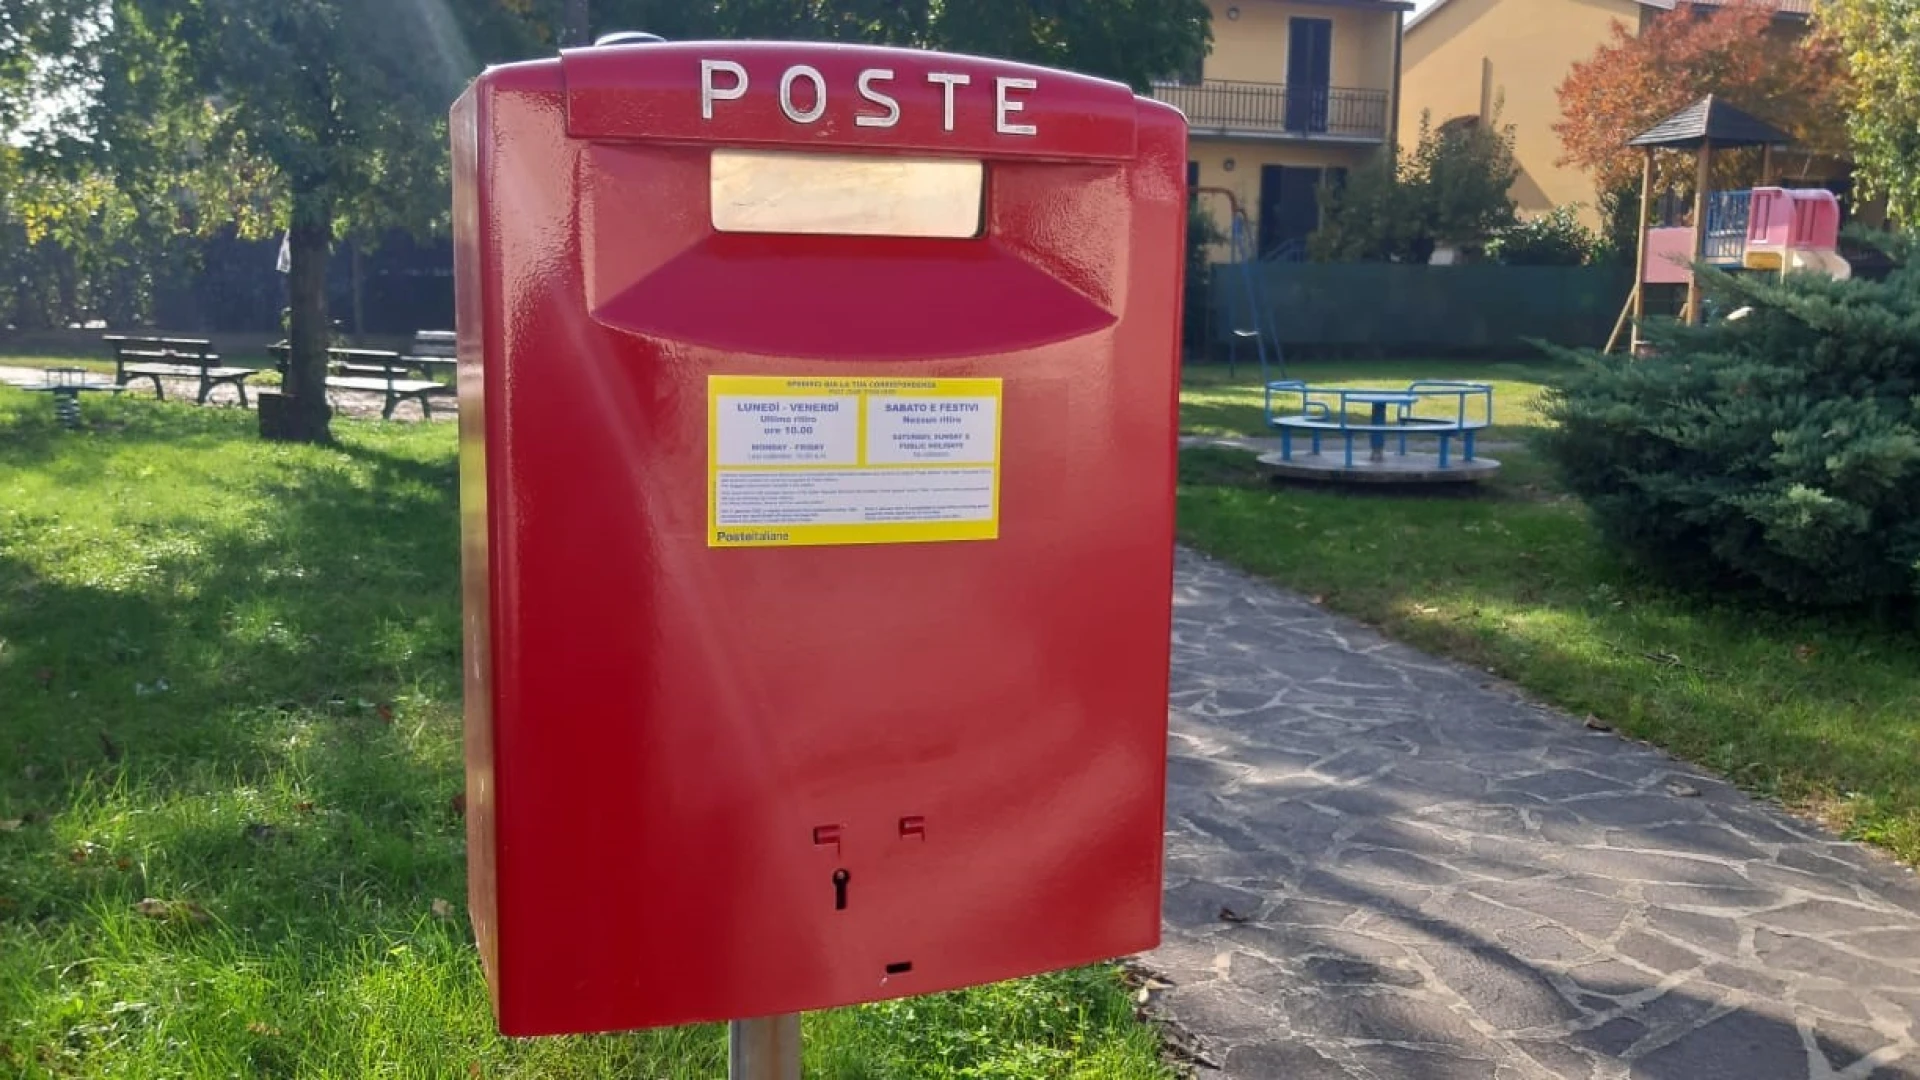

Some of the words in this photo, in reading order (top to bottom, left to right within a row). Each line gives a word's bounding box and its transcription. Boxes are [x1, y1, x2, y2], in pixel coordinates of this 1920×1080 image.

[700, 59, 1038, 136] POSTE
[737, 401, 780, 412] LUNEDÌ
[789, 401, 839, 412] VENERDÌ
[885, 403, 927, 413] SABATO
[930, 403, 938, 413] E
[939, 403, 979, 413] FESTIVI
[760, 415, 792, 424] Ultimo
[793, 415, 817, 424] ritiro
[902, 416, 938, 425] Nessun
[939, 415, 963, 424] ritiro
[763, 427, 782, 435] ore
